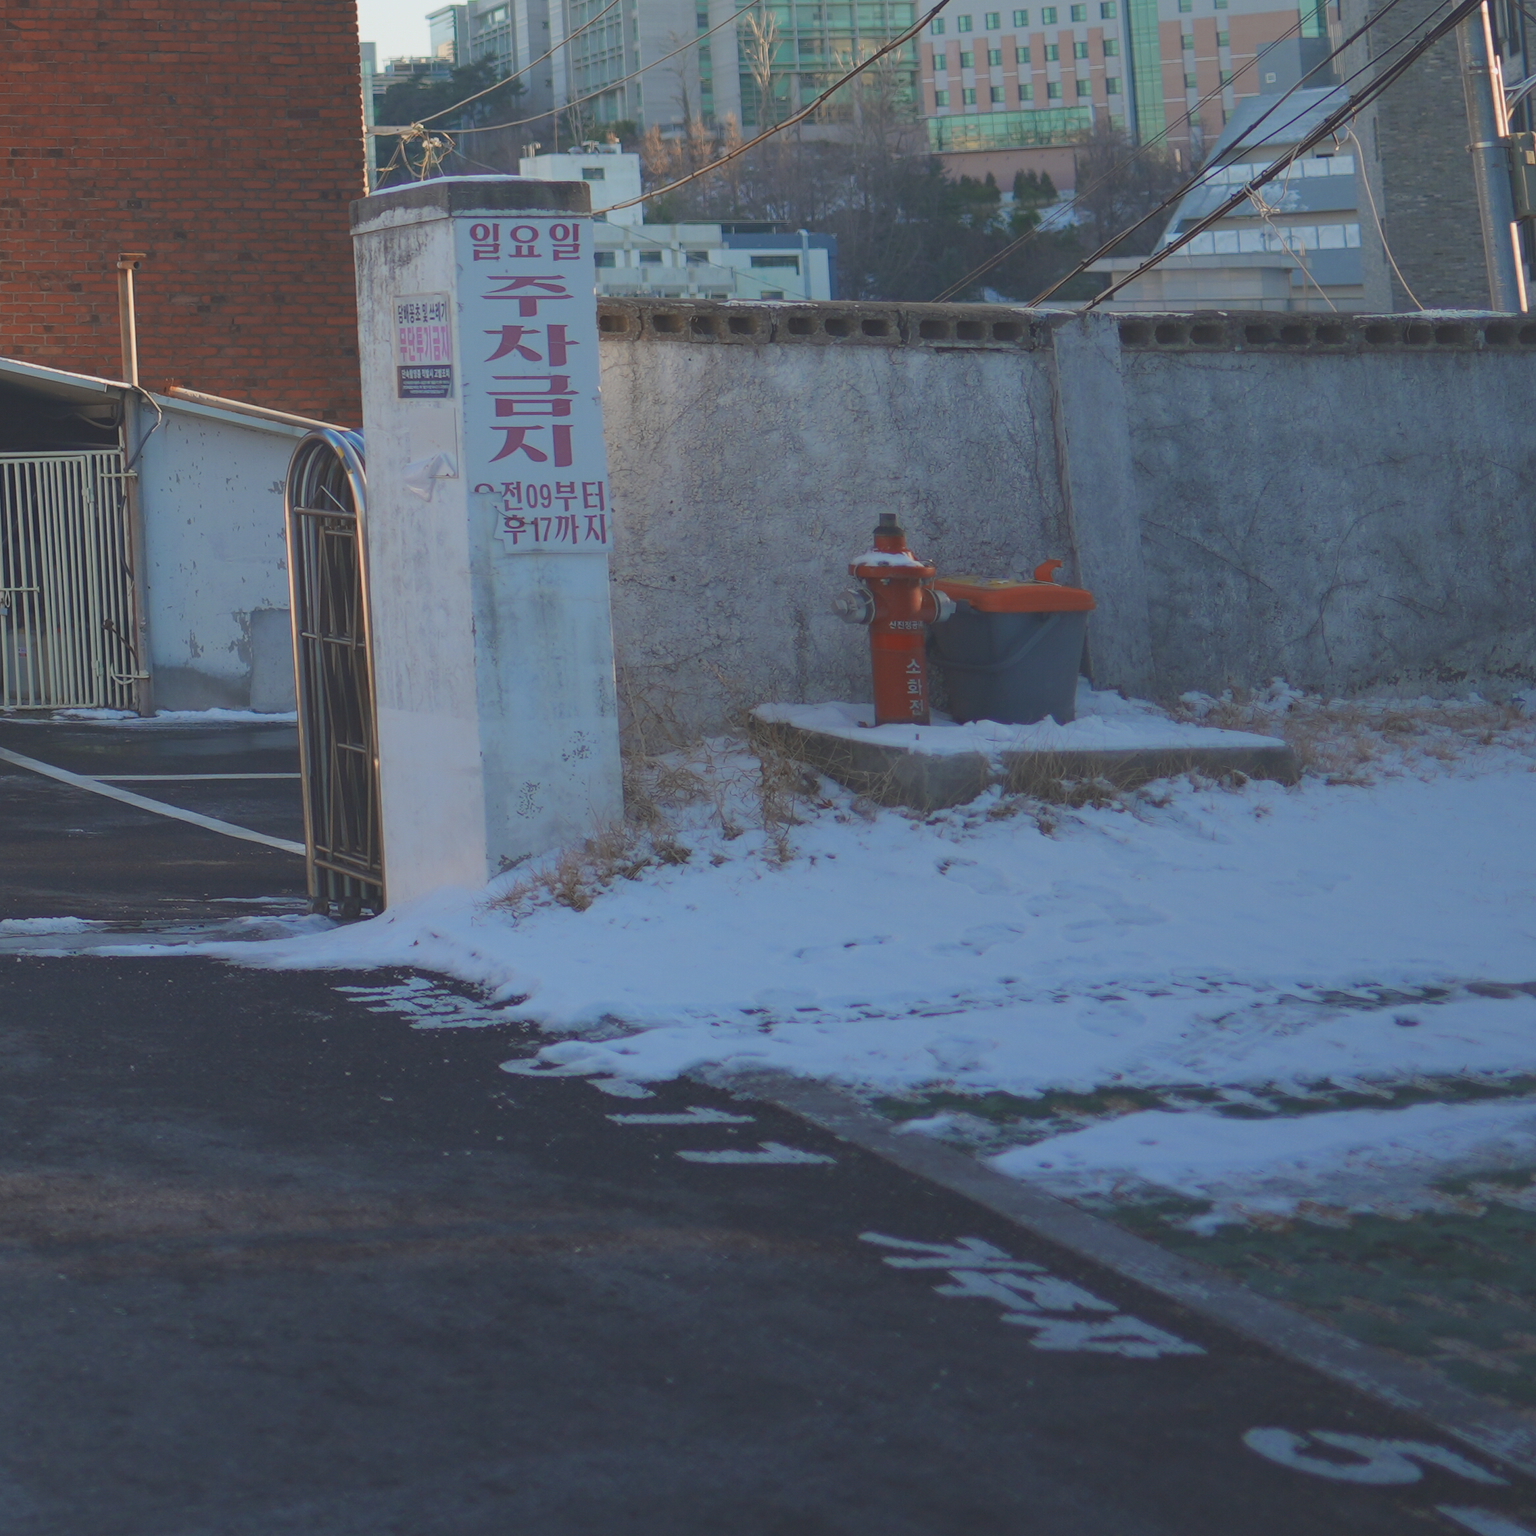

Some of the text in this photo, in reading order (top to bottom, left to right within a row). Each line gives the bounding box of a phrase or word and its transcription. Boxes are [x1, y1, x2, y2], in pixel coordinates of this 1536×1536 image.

[469, 222, 581, 262] 일요일
[480, 274, 581, 467] 주차금지
[906, 658, 924, 715] 소화전
